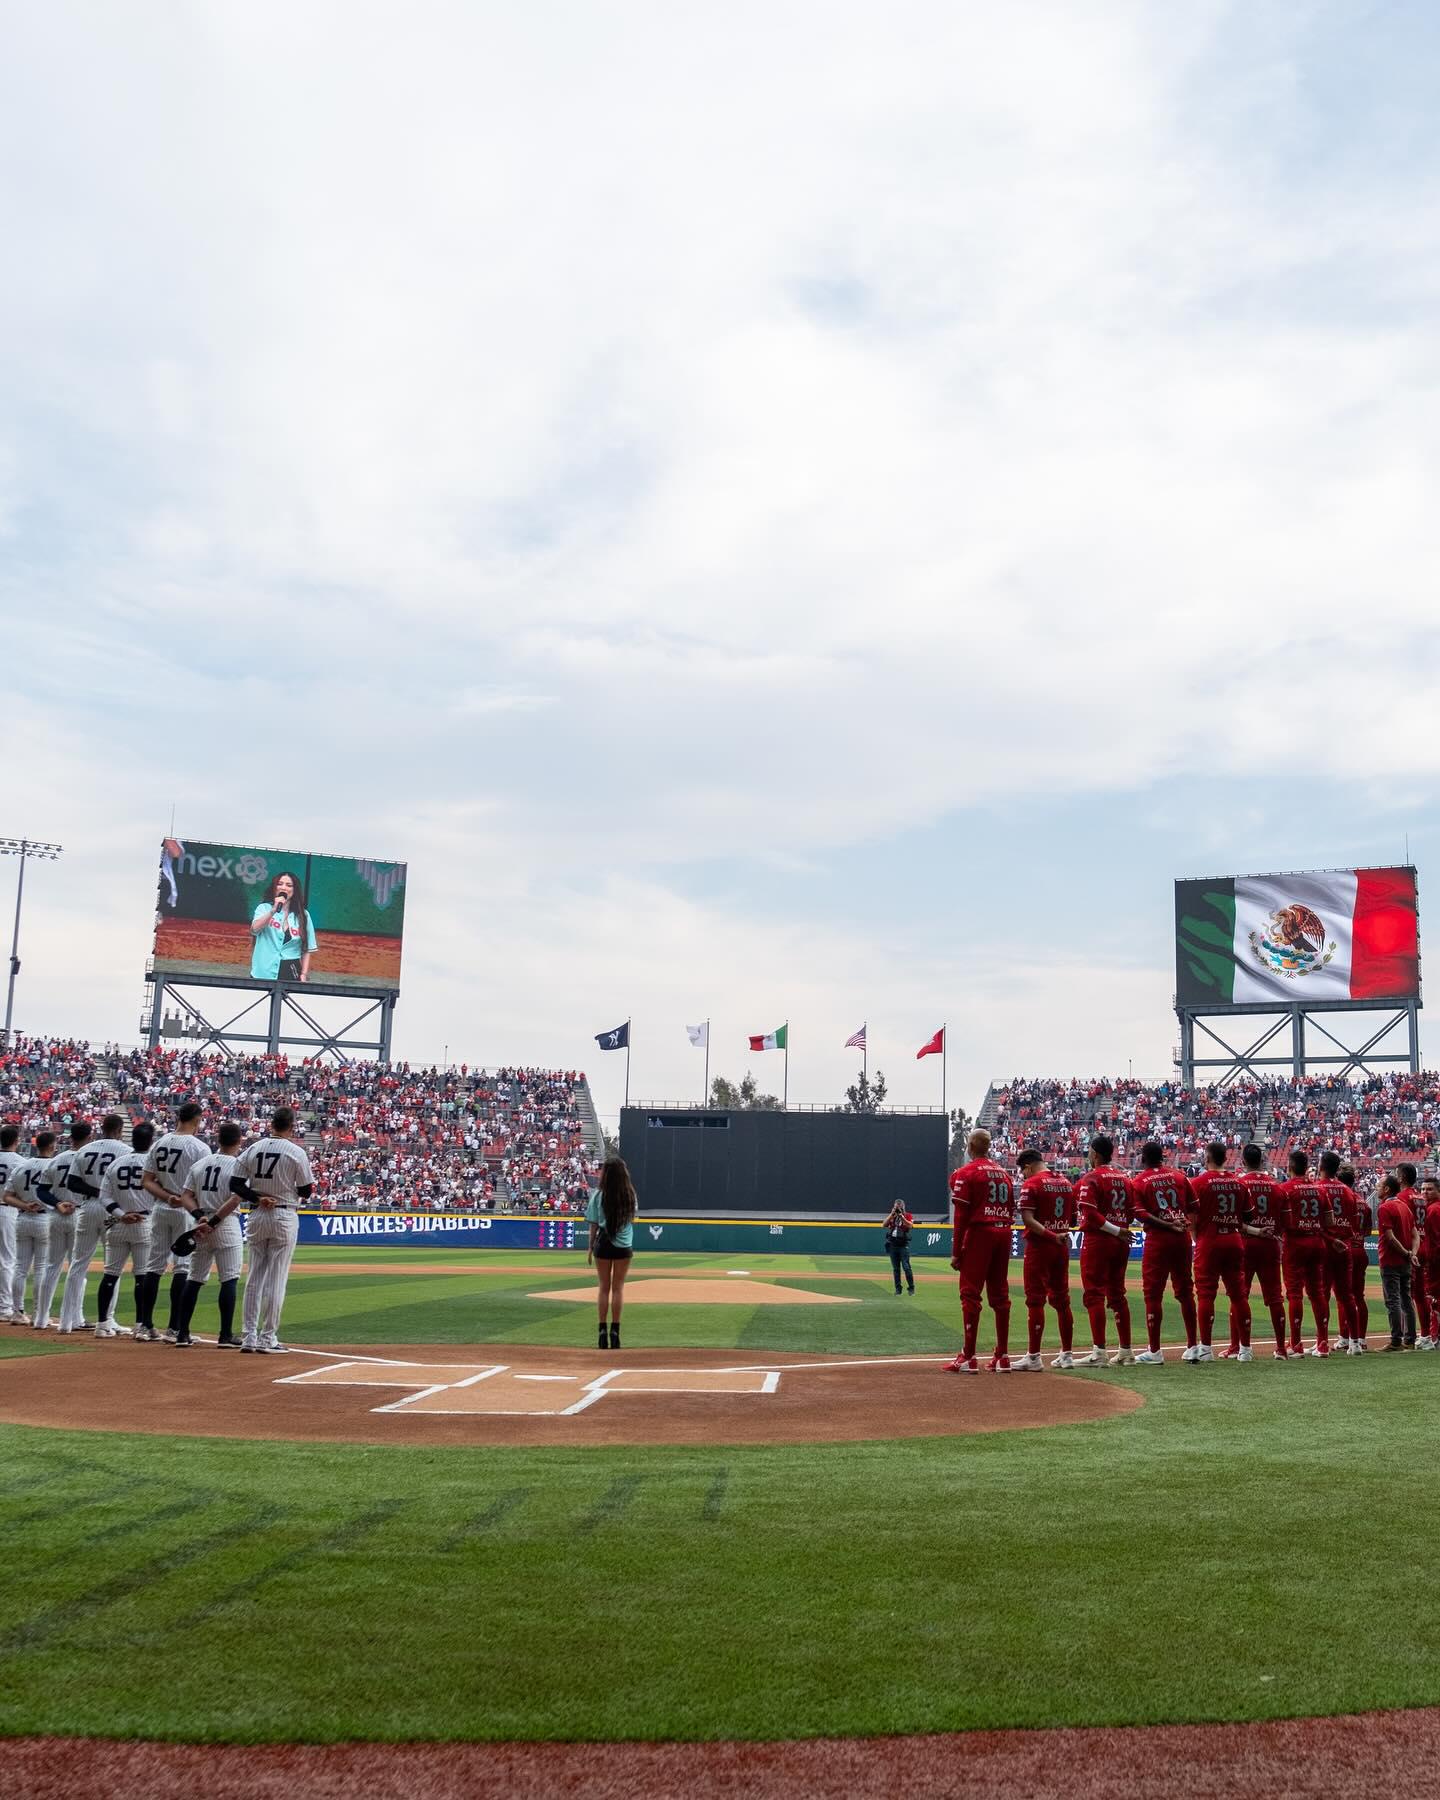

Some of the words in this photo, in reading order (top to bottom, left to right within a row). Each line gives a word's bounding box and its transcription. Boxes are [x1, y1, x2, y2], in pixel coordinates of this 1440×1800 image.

[84, 1152, 116, 1175] 72
[156, 1147, 183, 1173] 27
[255, 1152, 281, 1179] 17
[57, 1165, 71, 1188] 7
[117, 1166, 144, 1190] 95
[202, 1166, 221, 1192] 11
[988, 1180, 1008, 1204] 30
[1111, 1189, 1127, 1210] 22
[1155, 1188, 1179, 1210] 67
[985, 1207, 996, 1216] Red
[996, 1207, 1010, 1217] Cola
[1055, 1196, 1065, 1218] 8
[1217, 1193, 1237, 1214] 31
[1256, 1194, 1268, 1215] 9
[1300, 1198, 1320, 1217] 23
[1333, 1197, 1343, 1216] 5
[317, 1216, 407, 1235] YANKEES
[412, 1217, 492, 1232] DIABLOS
[1259, 1216, 1276, 1225] Cola
